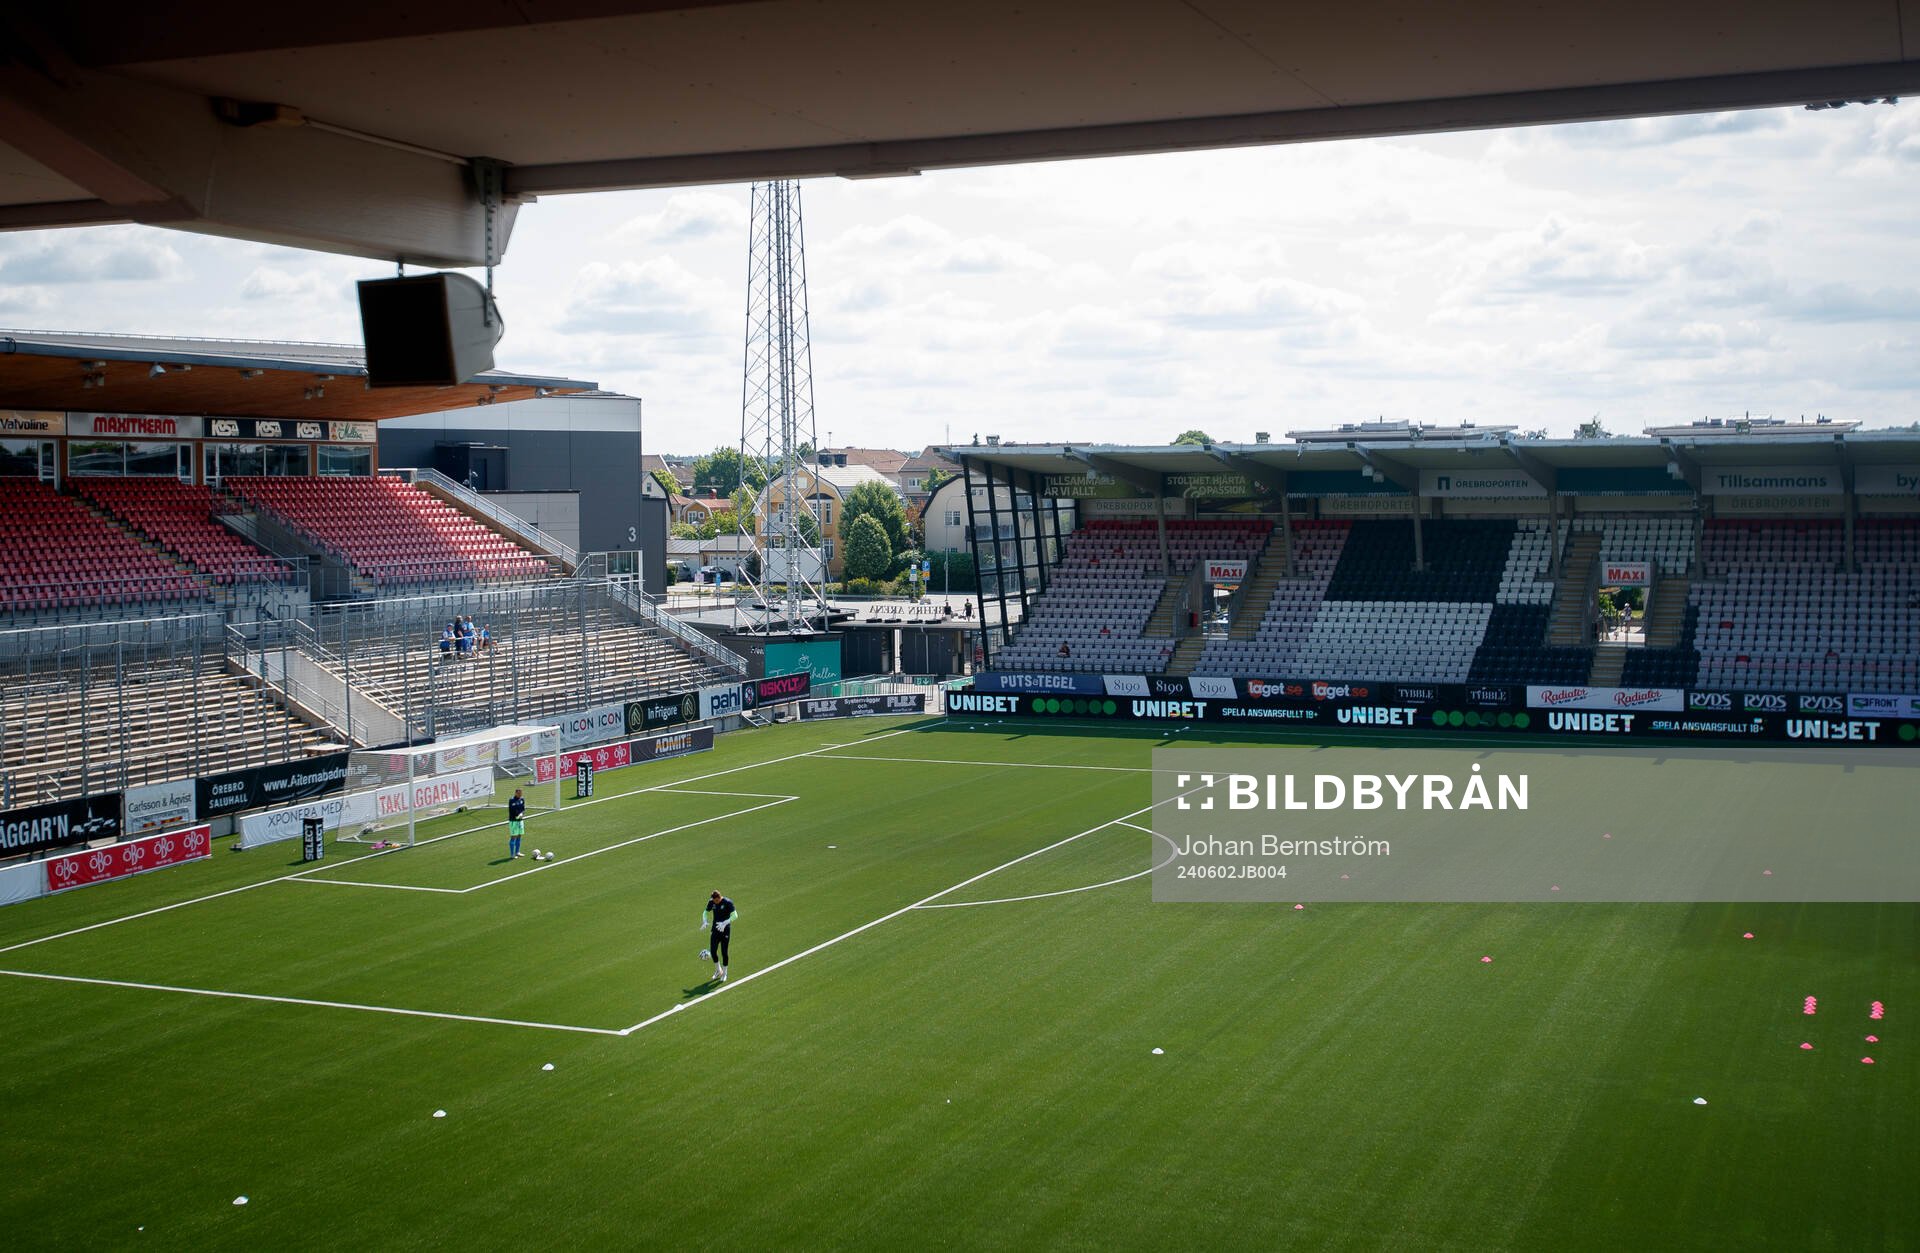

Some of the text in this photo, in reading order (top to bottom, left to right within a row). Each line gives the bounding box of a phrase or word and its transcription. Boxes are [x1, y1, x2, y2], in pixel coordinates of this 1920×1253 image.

[0, 418, 49, 431] Valvoline
[93, 416, 177, 435] MAXITHERM
[1718, 474, 1827, 488] Tillsammans
[1058, 486, 1070, 496] VI
[628, 526, 637, 543] 3
[1114, 679, 1140, 693] 8190
[1156, 680, 1182, 694] 8190
[1199, 681, 1226, 695] 8190
[1248, 681, 1304, 698] laget.se
[1312, 683, 1369, 699] laget.se
[711, 687, 741, 717] pahl
[807, 700, 838, 713] FLEX
[886, 695, 917, 708] FLEX
[949, 695, 1020, 713] UNIBET
[1689, 692, 1732, 706] RYDS
[1744, 693, 1787, 708] RYDS
[1800, 695, 1844, 709] RYDS
[1132, 700, 1207, 718] UNIBET
[1222, 707, 1246, 717] SPELA
[1247, 708, 1304, 719] ANSVARSFULLT
[1337, 706, 1418, 726] UNIBET
[570, 716, 594, 732] ICON
[599, 711, 622, 728] ICON
[1548, 712, 1636, 732] UNIBET
[1652, 720, 1681, 731] SPELA
[1682, 721, 1747, 733] ANSVARSFULLT
[212, 781, 245, 796] ÖREBRO
[128, 793, 192, 813] Carlsson & Åqvist
[209, 793, 248, 809] SALUHALL
[379, 781, 461, 815] TAKLGGAR'N
[305, 823, 314, 860] SELECT
